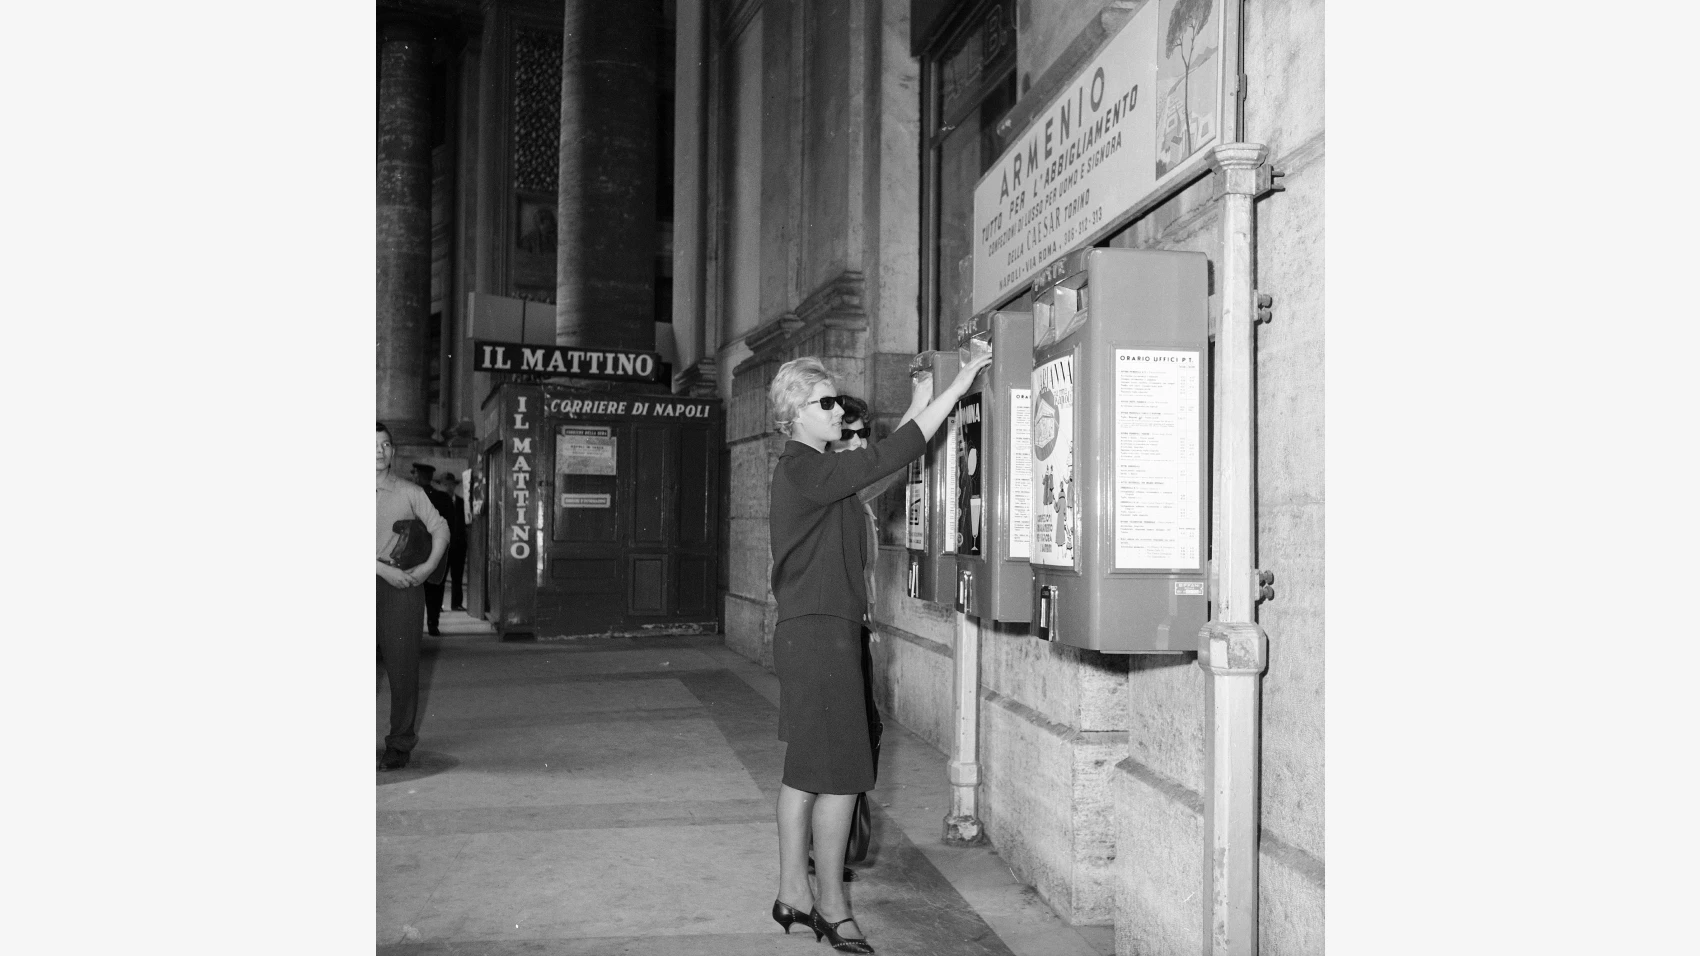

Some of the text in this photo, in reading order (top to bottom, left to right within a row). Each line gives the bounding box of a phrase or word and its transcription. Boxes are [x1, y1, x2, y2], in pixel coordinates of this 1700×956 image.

[982, 84, 1139, 246] TUTTO PER L'ABBIGLIAMENTO
[988, 130, 1123, 258] CONFEZIONI DI LUSSO PER UOMO E SIGNORA
[1000, 66, 1105, 205] ARMENIO
[1007, 187, 1090, 267] DELLA CAESAR TORINO
[482, 345, 655, 378] IL MATTINO
[550, 398, 711, 418] CORRIERE DI NAPOLI
[509, 396, 533, 561] IL MATTINO
